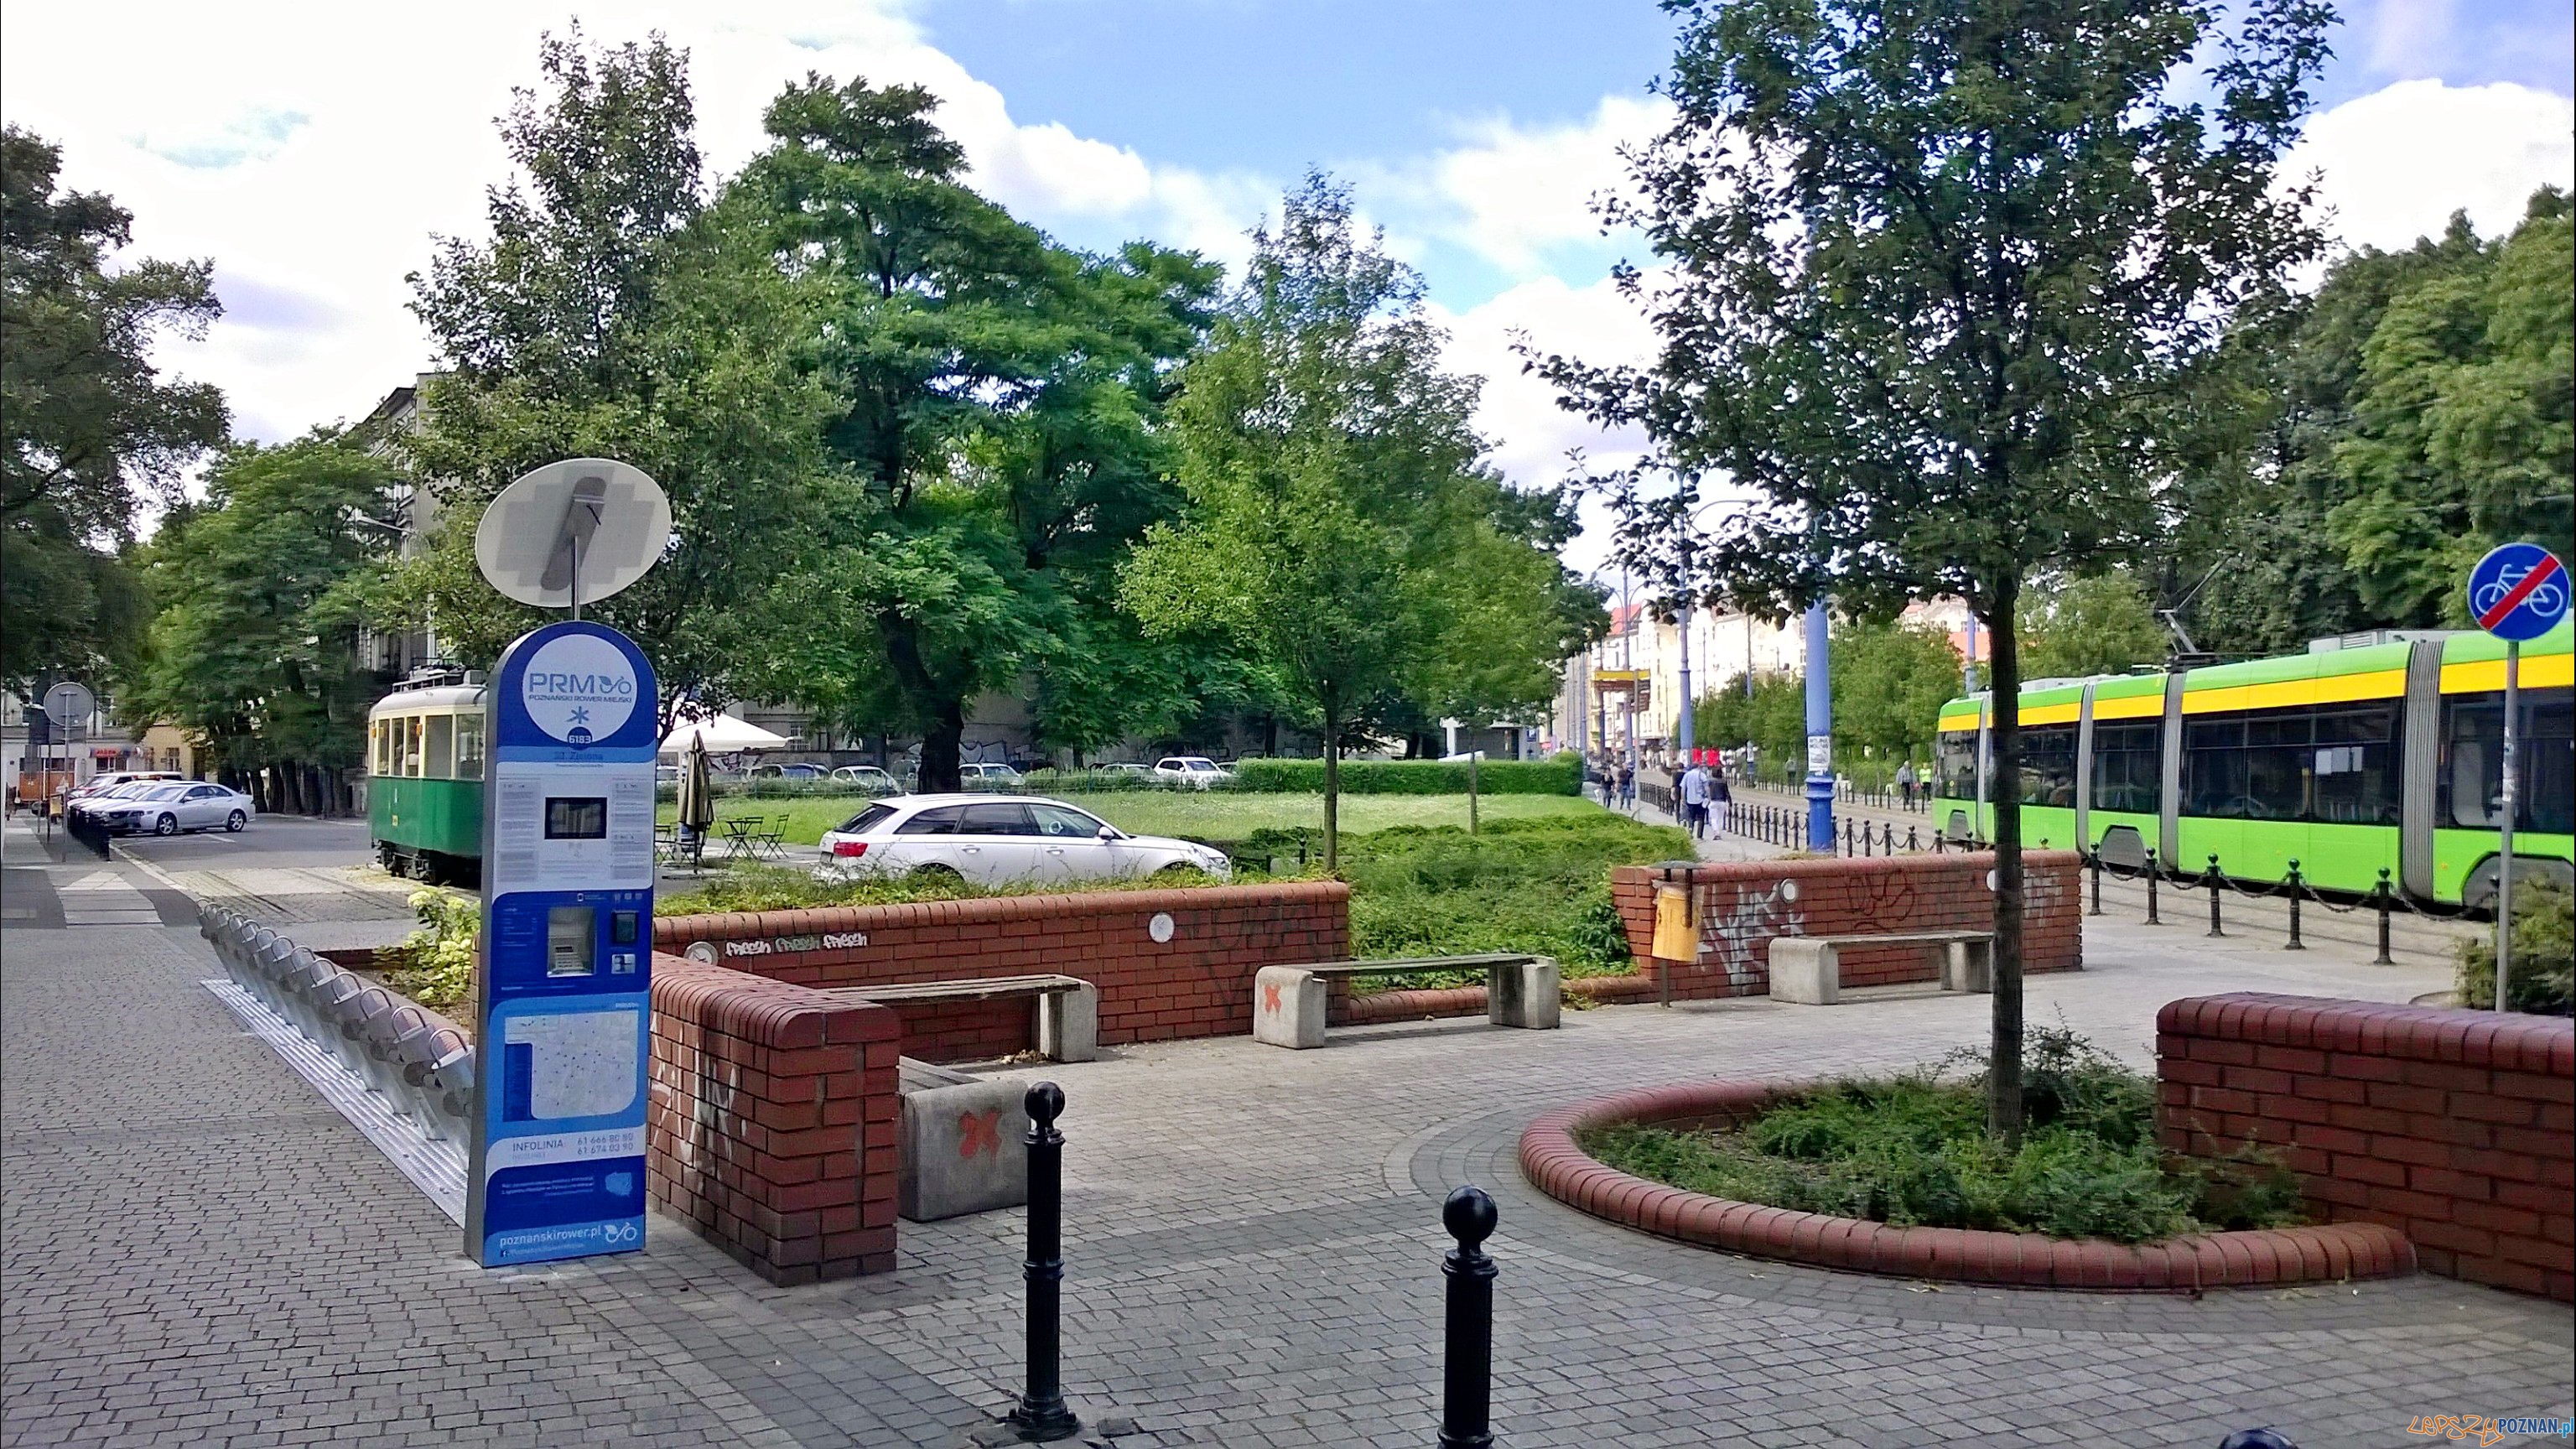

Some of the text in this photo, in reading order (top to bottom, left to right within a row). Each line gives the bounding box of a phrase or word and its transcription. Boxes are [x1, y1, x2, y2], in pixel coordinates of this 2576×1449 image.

[529, 673, 595, 693] PRM
[569, 735, 591, 744] 6183
[512, 1139, 564, 1151] INFOLINIA
